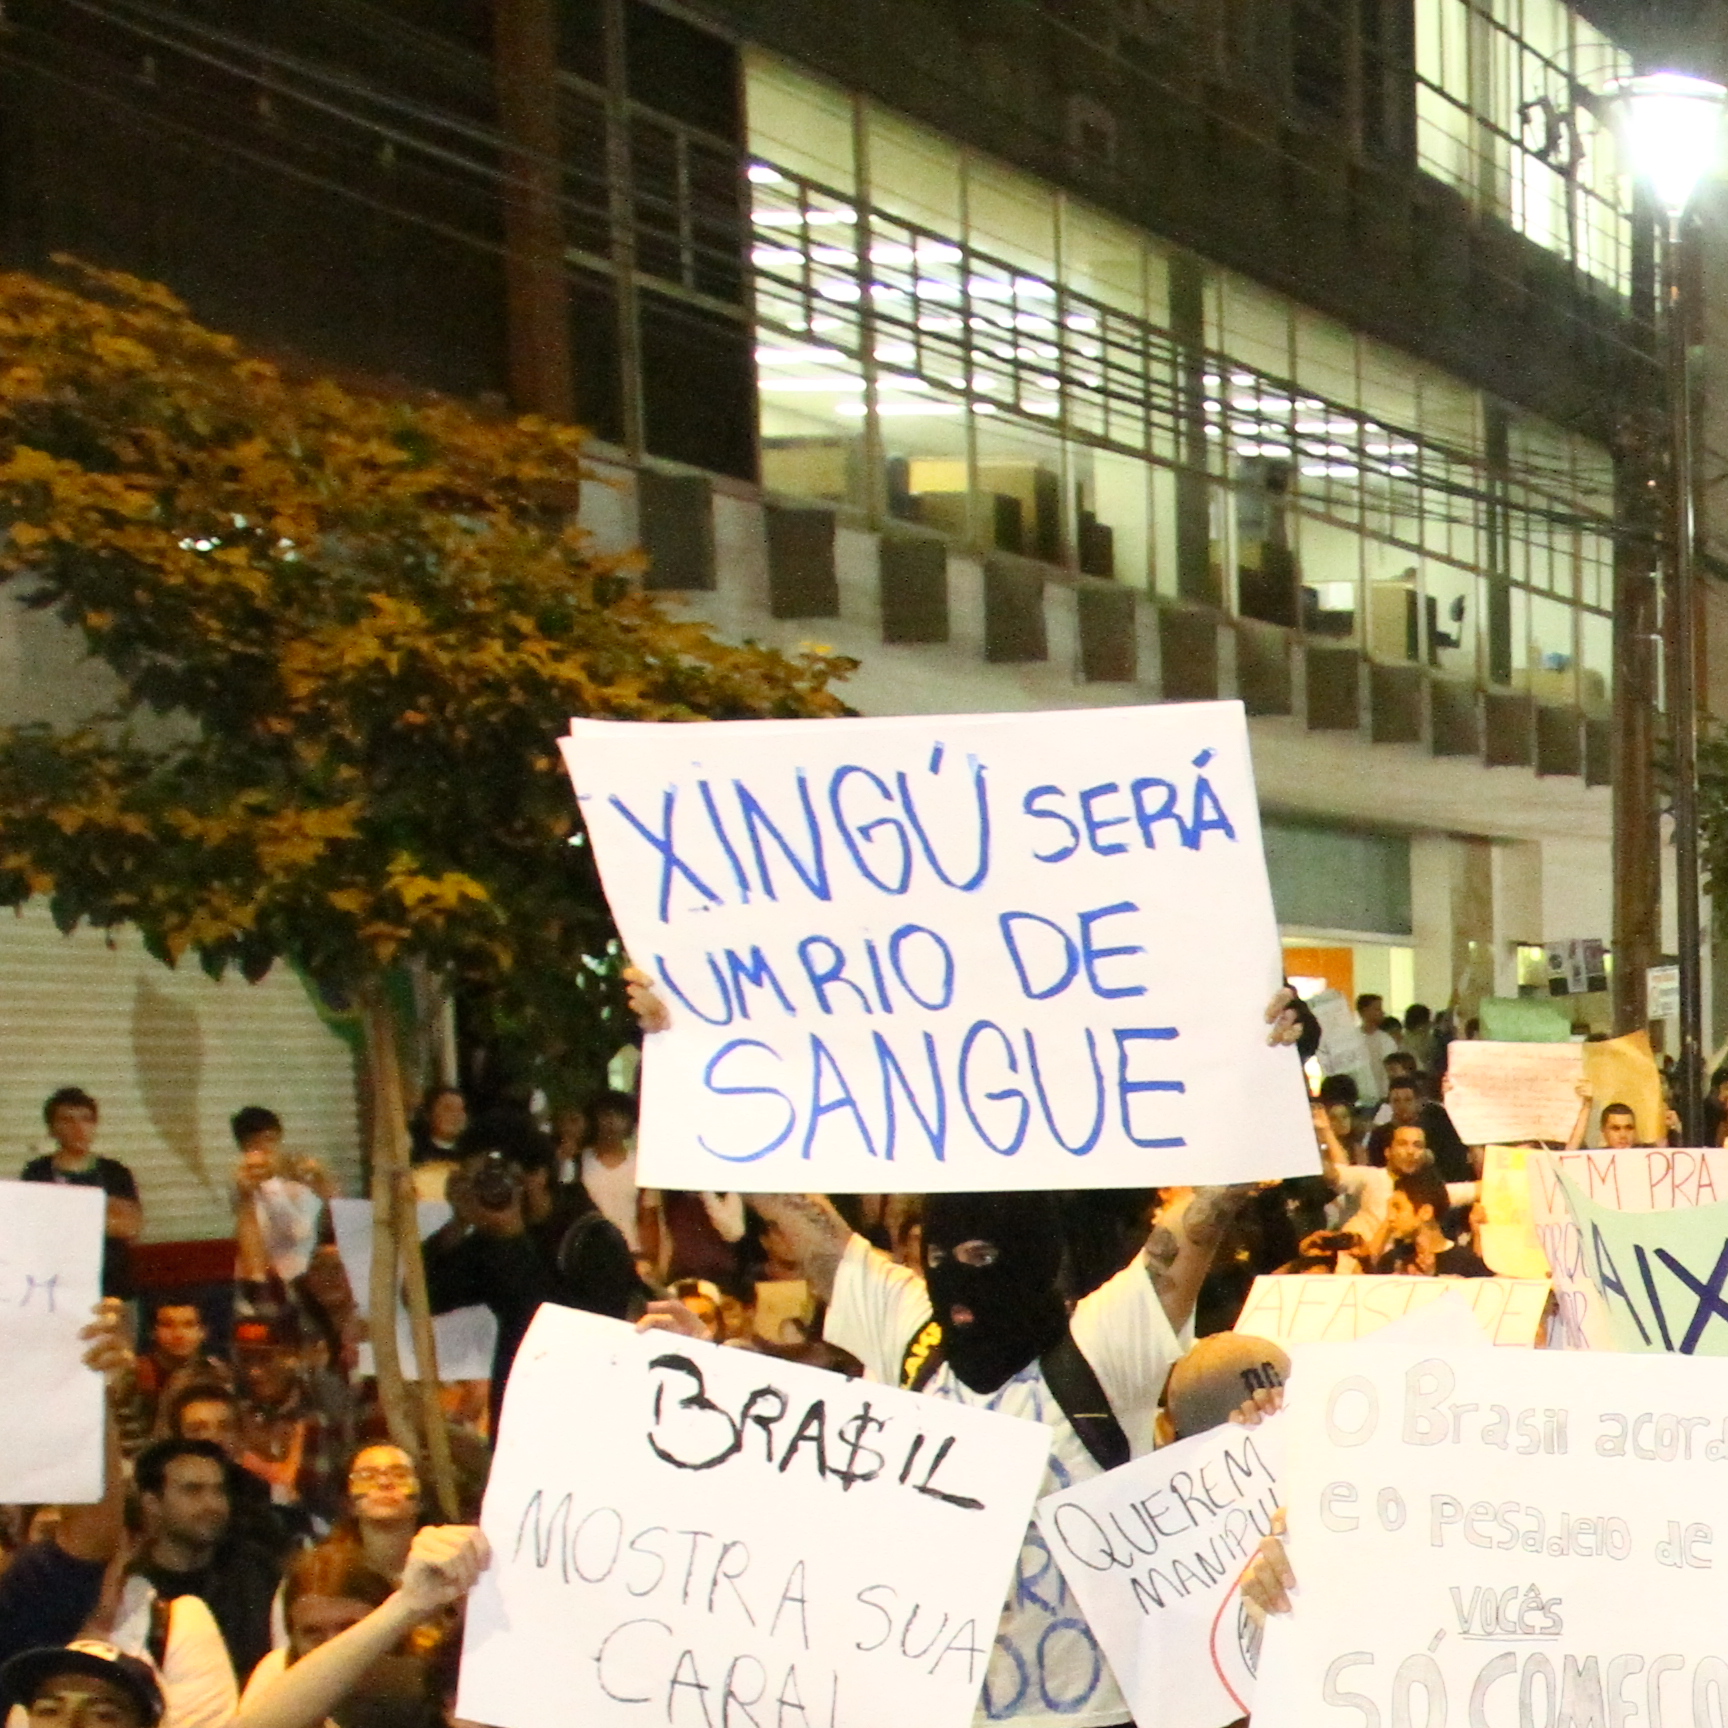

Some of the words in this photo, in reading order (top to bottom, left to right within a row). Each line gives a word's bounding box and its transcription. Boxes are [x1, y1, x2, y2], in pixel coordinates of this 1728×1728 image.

[607, 738, 992, 923] XINGÚ
[1021, 746, 1238, 864] SERÁ
[652, 940, 797, 1027] UM
[798, 922, 957, 1017] RIO
[998, 900, 1148, 1001] DE
[696, 1018, 1187, 1163] SANGUE
[1646, 1151, 1719, 1210] PRA
[1326, 1375, 1379, 1449] O
[1403, 1357, 1570, 1457] Brasil
[1053, 1435, 1278, 1573] QUEREM
[1129, 1486, 1281, 1616] MANIPU
[1320, 1480, 1362, 1534] e
[1377, 1485, 1407, 1532] o
[1654, 1517, 1714, 1571] de
[511, 1486, 810, 1650] MOSTRA
[855, 1583, 988, 1686] SUA
